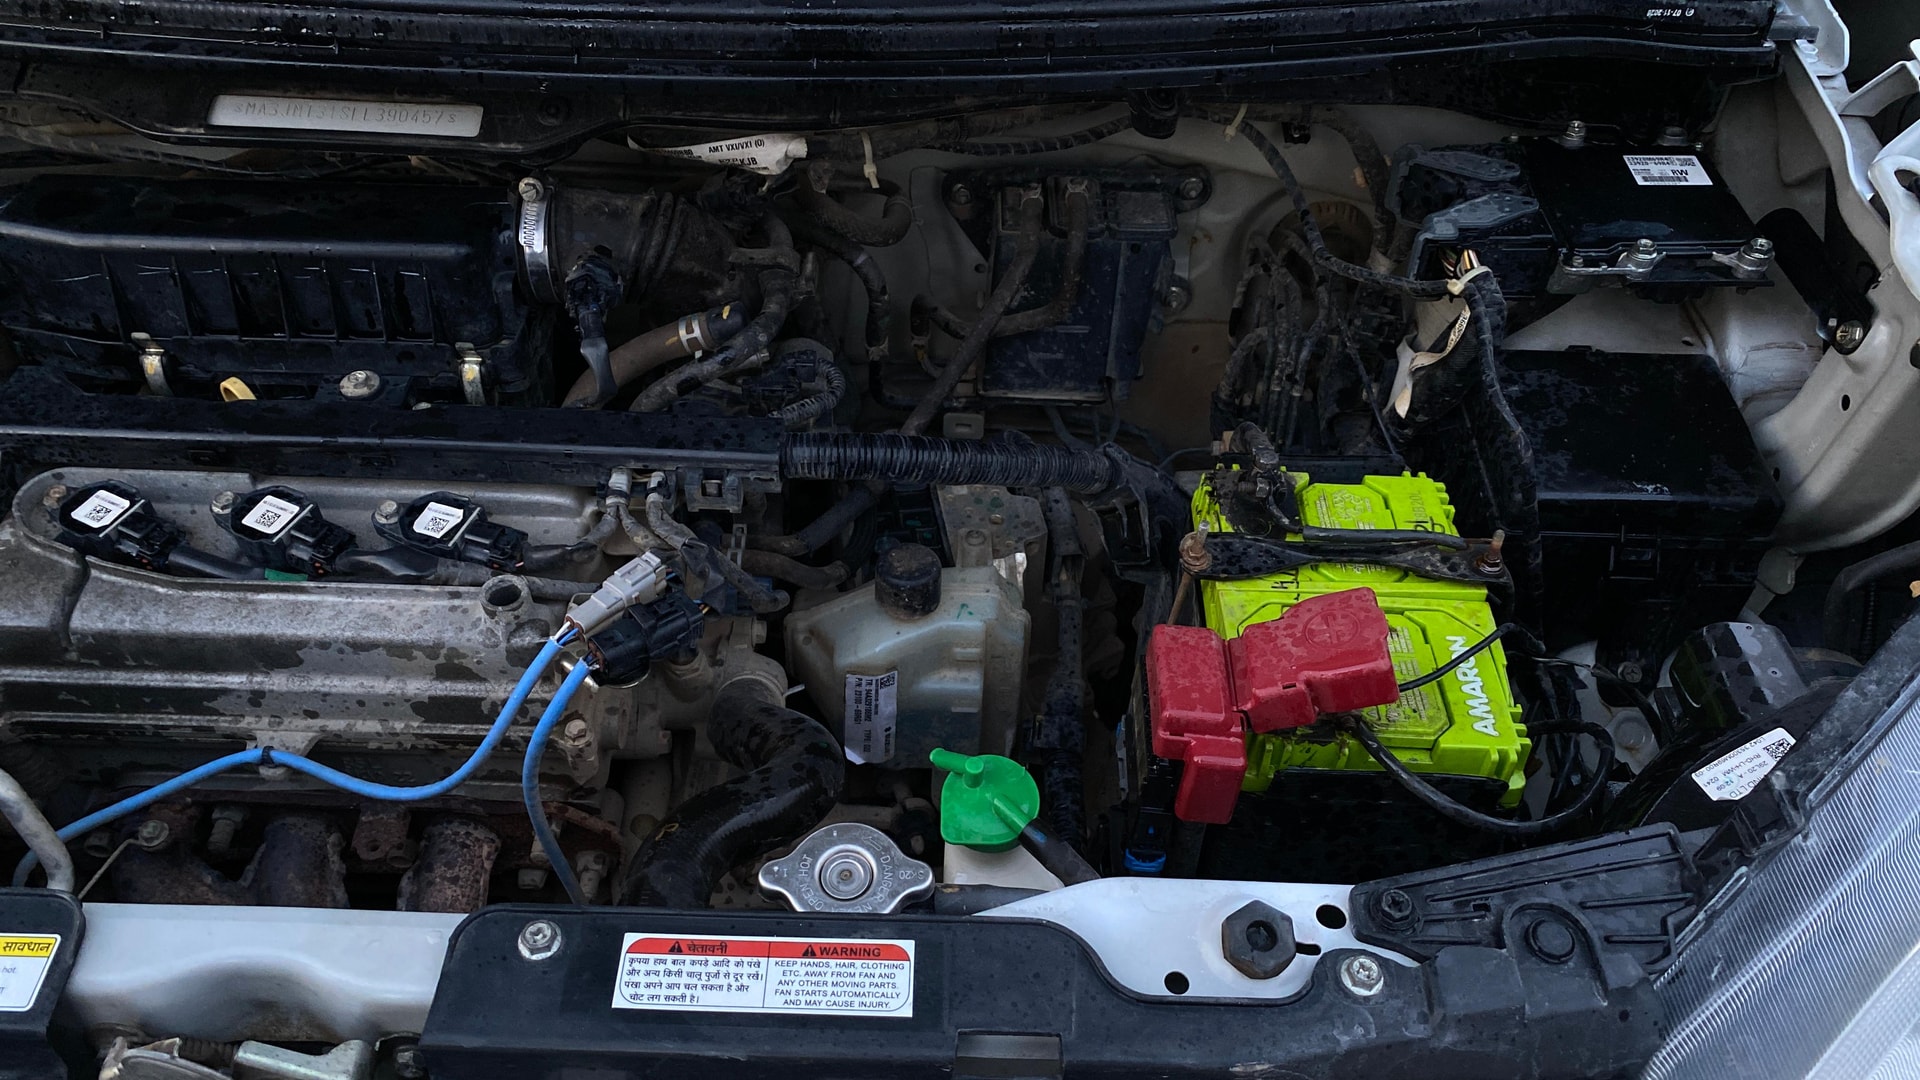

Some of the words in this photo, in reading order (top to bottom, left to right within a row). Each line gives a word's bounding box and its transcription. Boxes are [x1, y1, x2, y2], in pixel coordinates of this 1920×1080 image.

[708, 146, 724, 154] AMT
[1729, 785, 1748, 798] LTD
[799, 854, 814, 878] HOT
[878, 855, 893, 903] DANGER
[800, 883, 825, 911] OPEN
[3, 941, 52, 953] सावधान
[687, 941, 728, 954] चेतावनी
[820, 946, 881, 957] WARNING
[628, 957, 650, 967] कृपया
[653, 958, 667, 966] हाथ
[671, 958, 686, 967] बाल
[689, 957, 709, 968] कपड़े
[712, 957, 730, 968] आदि
[734, 958, 745, 968] को
[747, 959, 761, 969] पंखे
[800, 961, 832, 969] HANDS,
[835, 961, 858, 970] HAIR,
[860, 962, 905, 971] CLOTHING
[626, 967, 641, 977] और
[643, 968, 660, 977] अन्य
[663, 967, 683, 979] किसी
[686, 970, 703, 981] चालू
[723, 970, 731, 980] से
[733, 972, 744, 983] दूर
[804, 970, 828, 978] AWAY
[830, 971, 856, 979] FROM
[878, 972, 896, 980] AND
[624, 979, 641, 989] पंखा
[643, 980, 663, 990] अपने
[665, 981, 681, 990] आप
[683, 982, 698, 991] चल
[701, 983, 724, 992] सकता
[726, 983, 733, 993] है
[735, 983, 750, 992] और
[777, 979, 796, 987] ANY
[798, 980, 828, 988] OTHER
[831, 981, 866, 989] MOVING
[868, 981, 899, 989] PARTS.
[629, 991, 645, 1001] चोट
[647, 993, 661, 1002] लग
[663, 993, 687, 1003] सकती
[774, 988, 792, 996] FAN
[794, 989, 828, 997] STARTS
[830, 991, 901, 999] AUTOMATICALLY
[782, 998, 802, 1006] AND
[804, 999, 823, 1007] MAY
[825, 1000, 856, 1008] CAUSE
[858, 1001, 891, 1009] INJURY.
